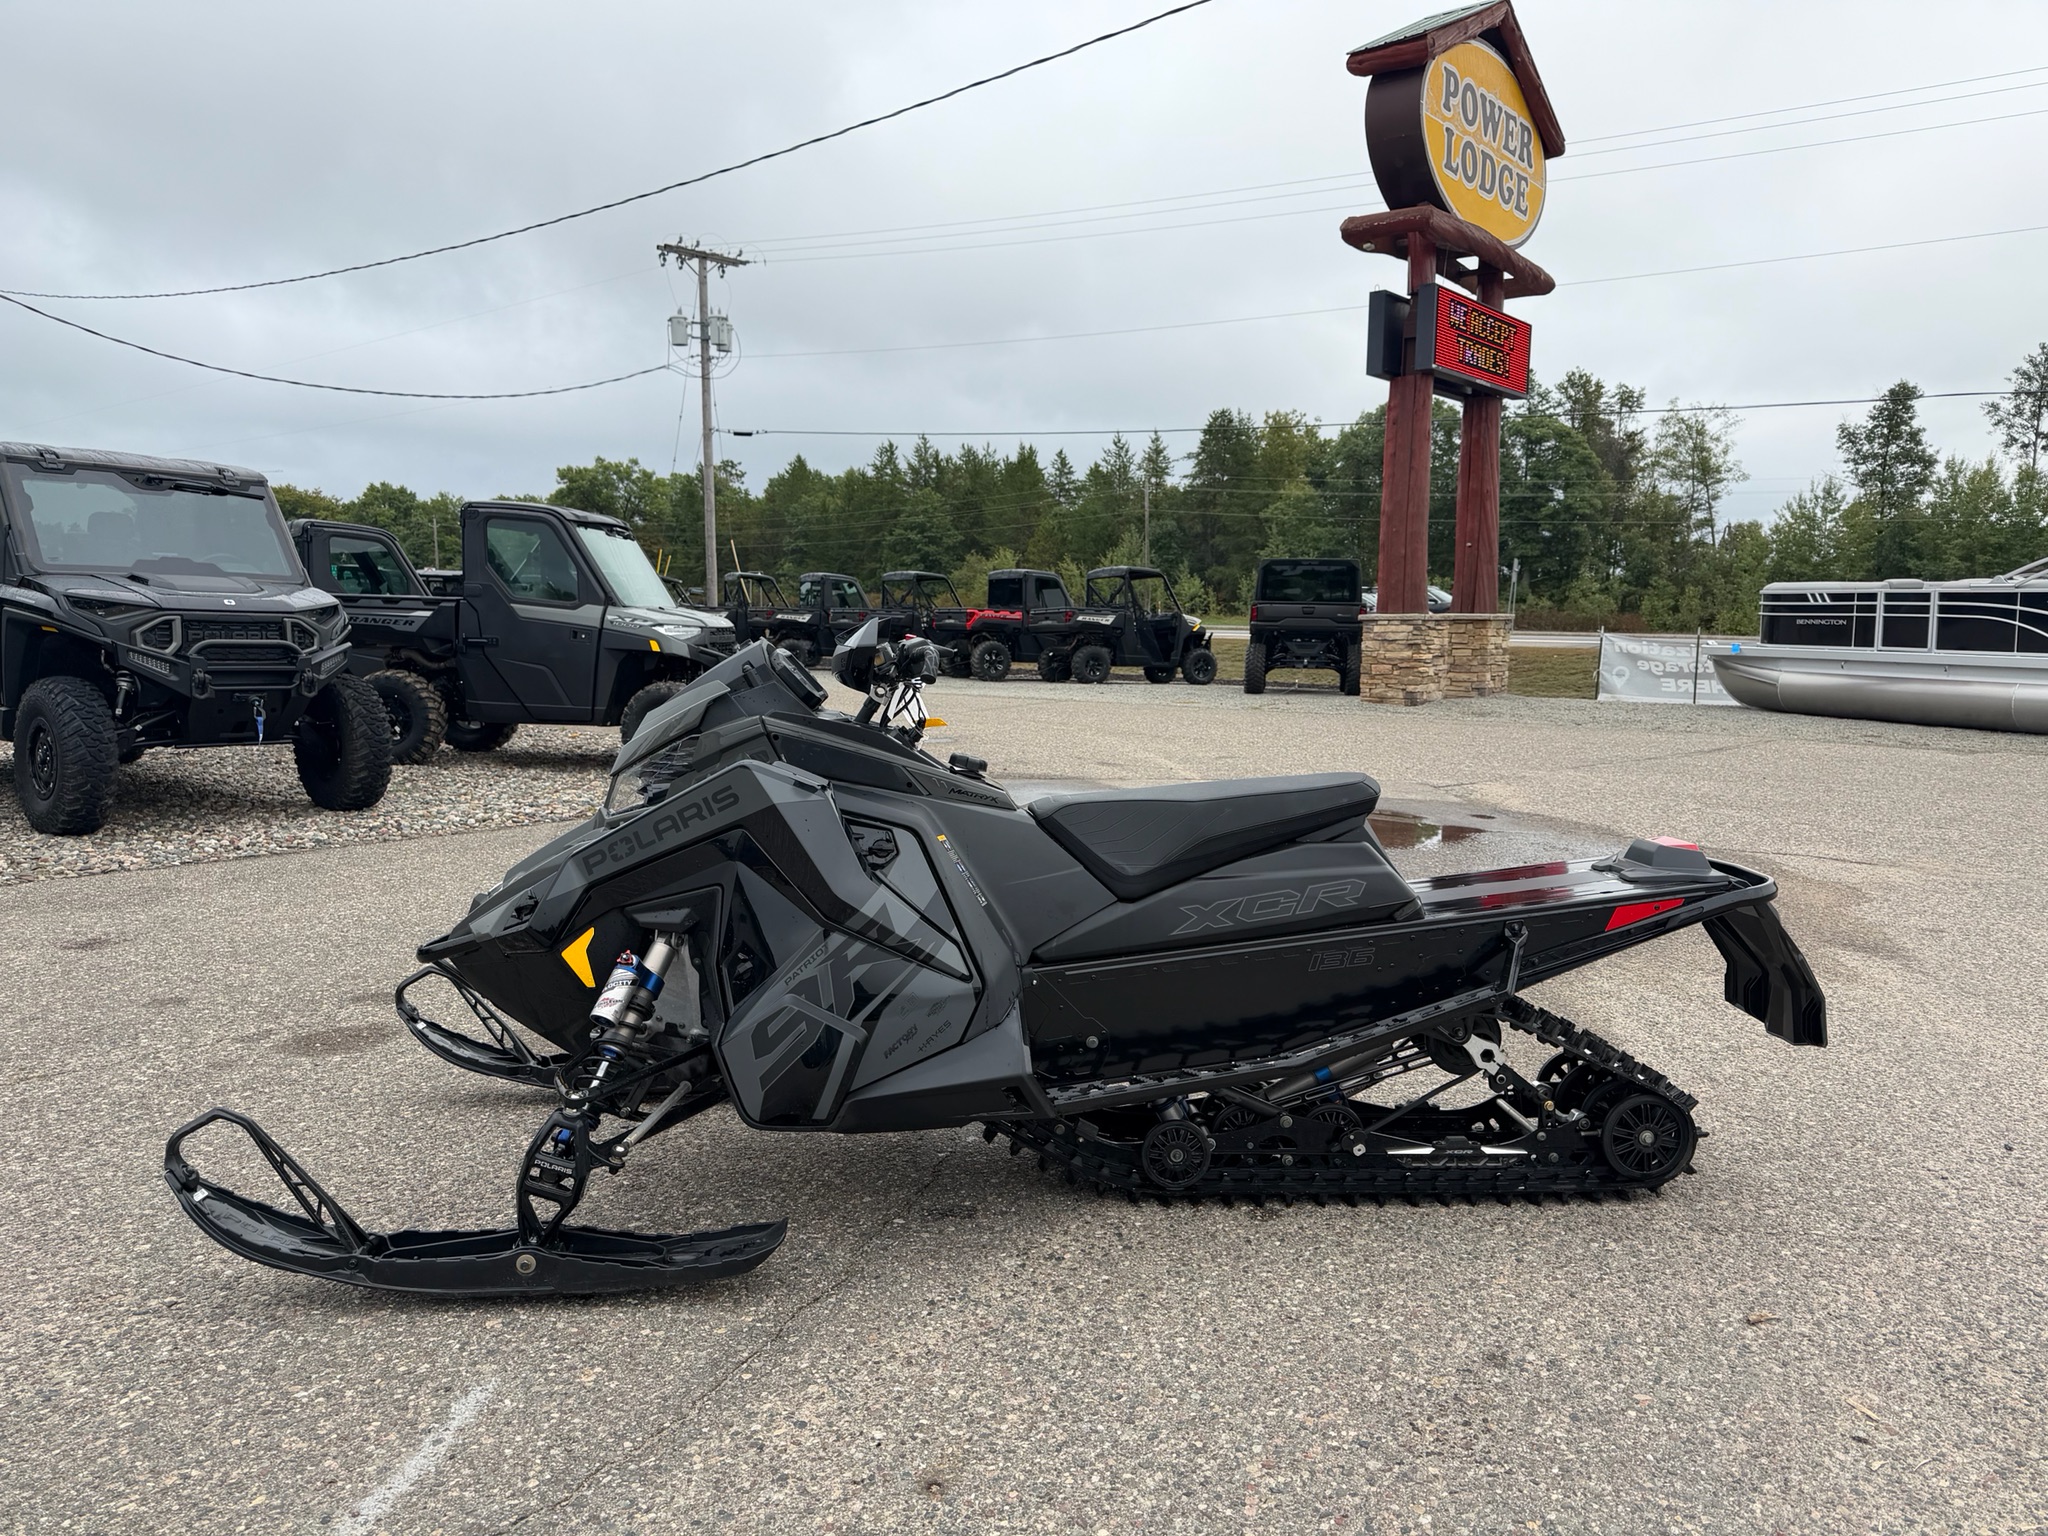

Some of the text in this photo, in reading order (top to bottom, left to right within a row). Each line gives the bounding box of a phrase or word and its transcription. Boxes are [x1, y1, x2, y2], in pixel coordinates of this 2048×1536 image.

[1442, 64, 1534, 171] POWER
[1443, 125, 1530, 219] LODGE
[1450, 301, 1517, 349] WE ACCEPT
[187, 630, 281, 641] POLARIS
[349, 616, 415, 626] RANGER
[613, 621, 640, 629] 1000
[1796, 618, 1847, 626] BENNINGTON
[948, 787, 999, 804] MATRYX
[582, 784, 740, 877] POLARIS
[1168, 878, 1367, 936] XCR
[784, 943, 829, 986] PATRIOT
[1307, 947, 1376, 972] 136
[883, 1024, 918, 1059] FACTORY
[918, 1020, 952, 1052] HAYES
[534, 1159, 573, 1175] POLARIS
